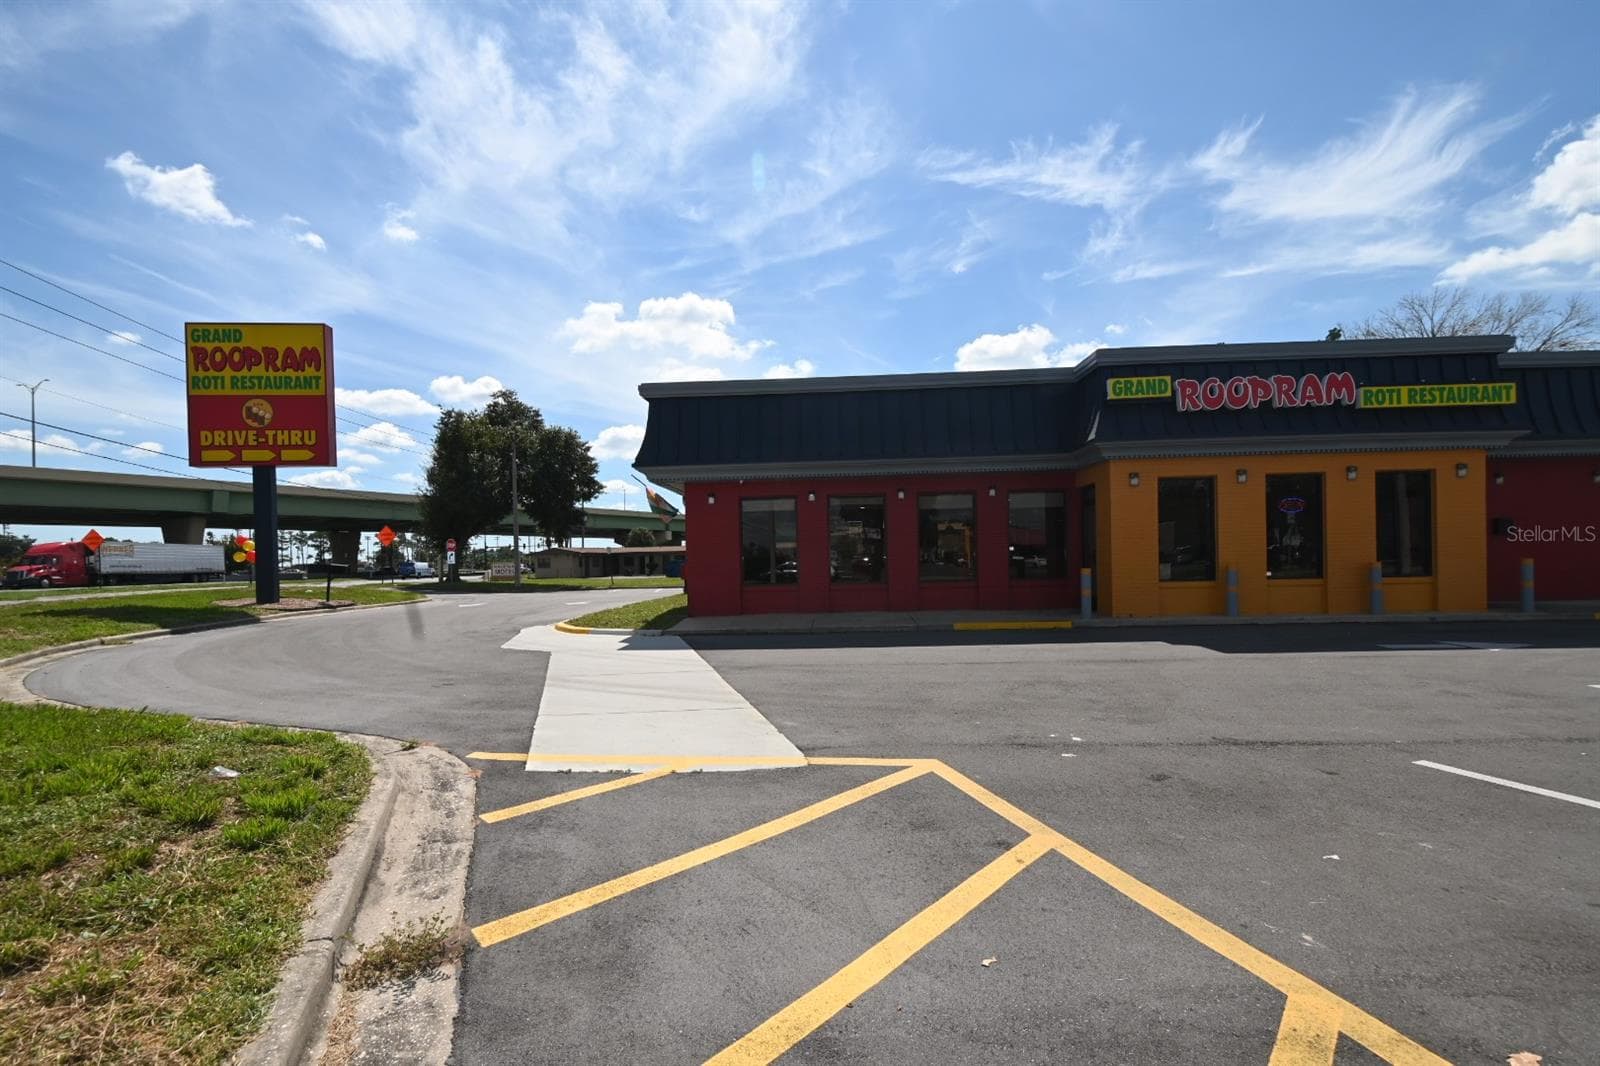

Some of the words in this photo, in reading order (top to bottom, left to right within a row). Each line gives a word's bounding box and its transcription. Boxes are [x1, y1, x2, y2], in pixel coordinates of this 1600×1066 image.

[191, 328, 243, 343] GRAND
[190, 346, 321, 372] ROOPRAM
[191, 375, 225, 390] ROTI
[231, 375, 321, 390] RESTAURANT
[1111, 378, 1169, 397] GRAND
[1175, 372, 1355, 411] ROOPRAM
[1362, 388, 1402, 407] ROTI
[1406, 384, 1513, 405] RESTAURANT
[200, 430, 316, 446] DRIVE-THRU
